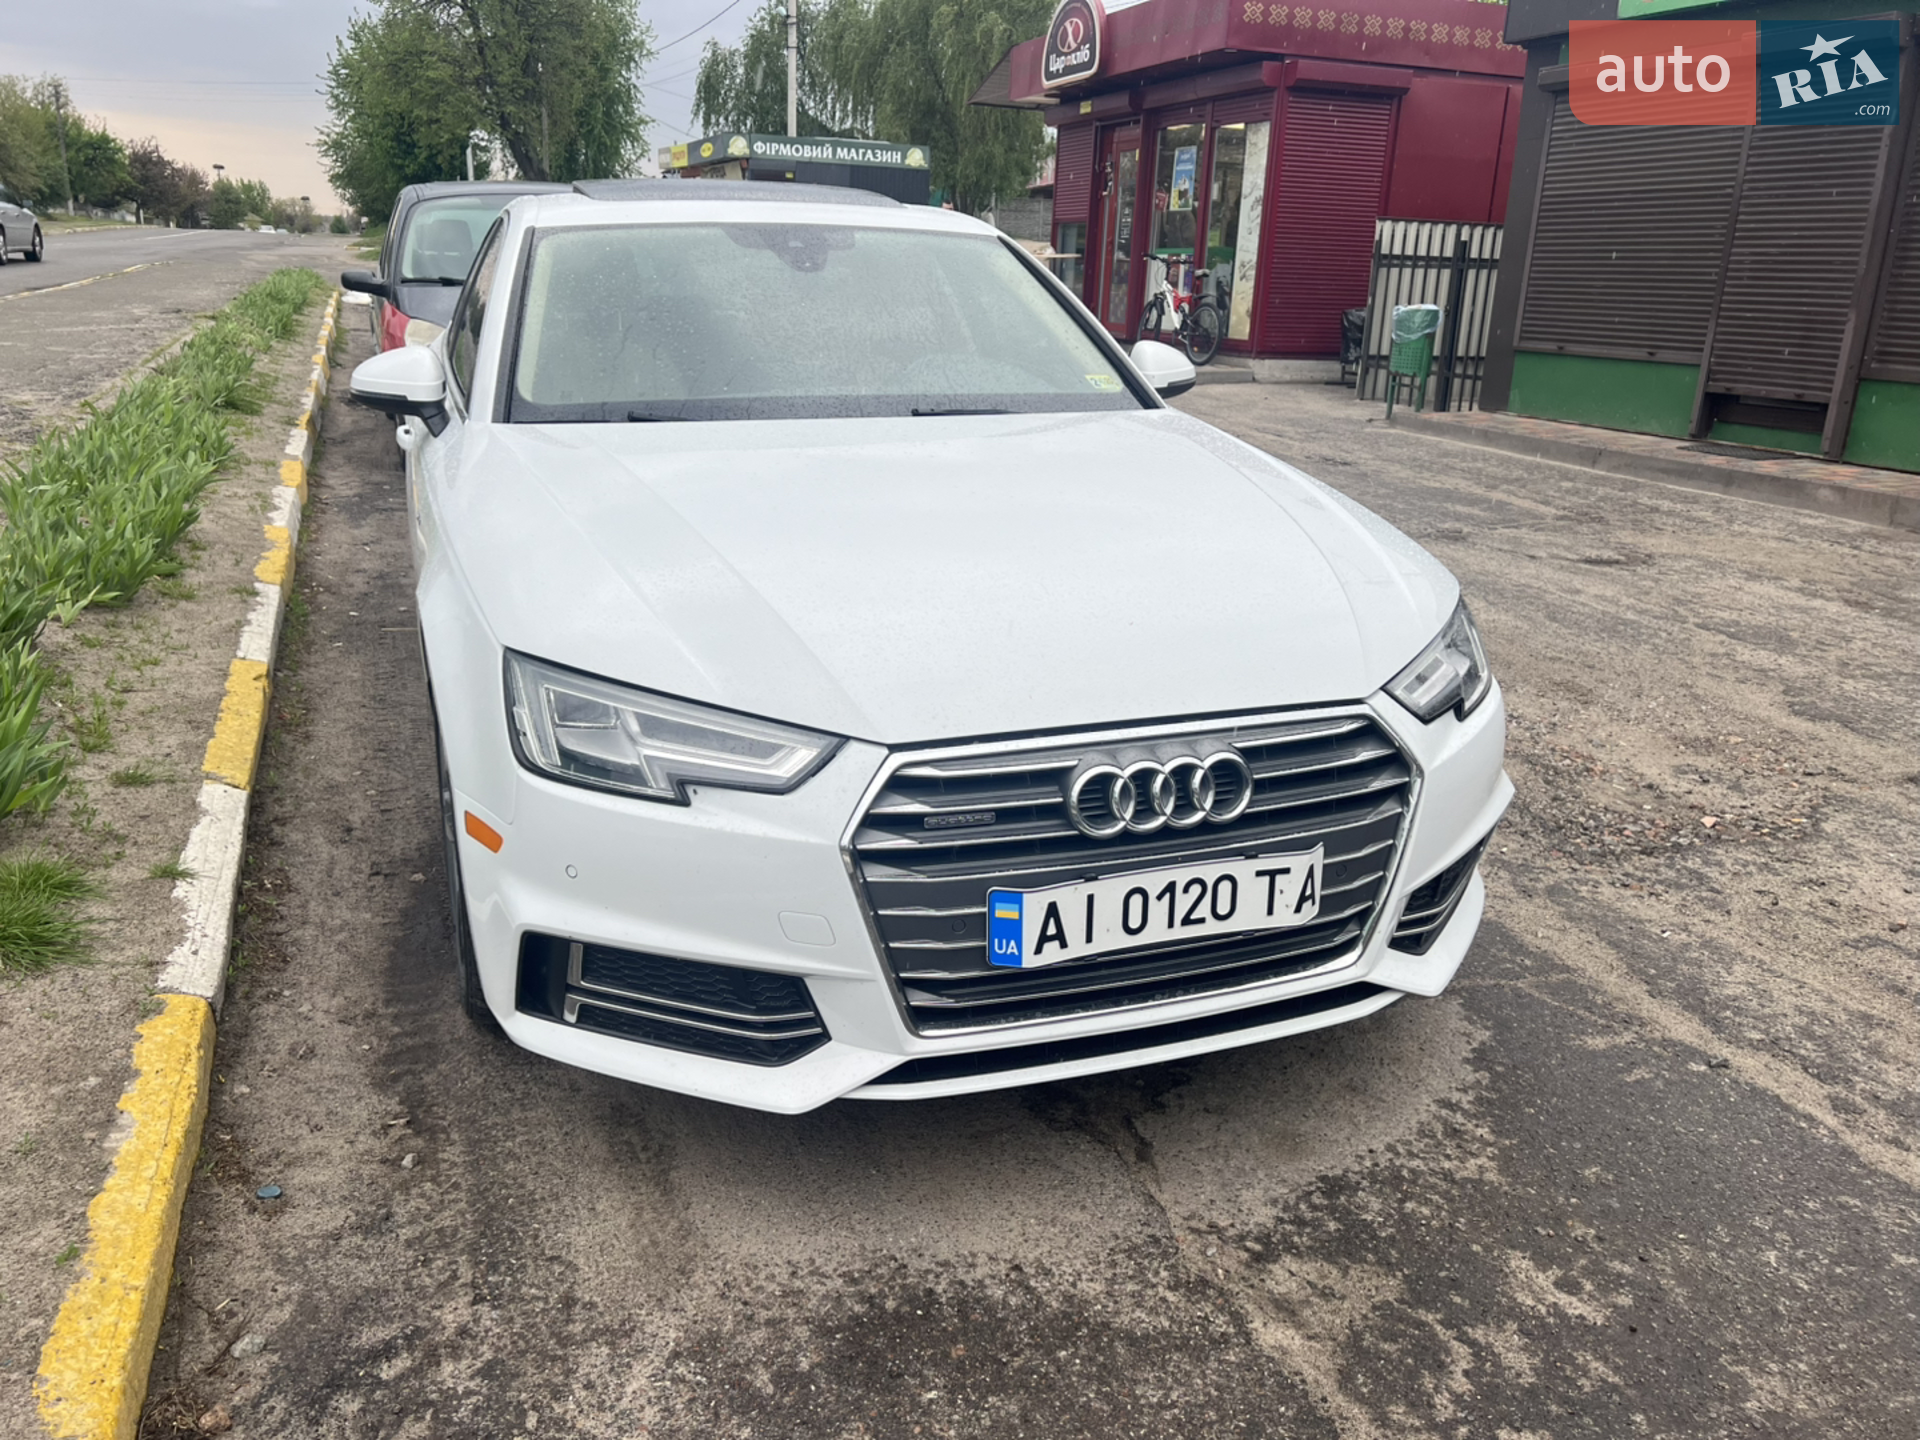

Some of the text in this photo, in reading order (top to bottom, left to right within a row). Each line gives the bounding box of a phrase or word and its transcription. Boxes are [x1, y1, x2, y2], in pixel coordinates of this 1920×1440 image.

[753, 141, 901, 164] ФІРМОВИЙ МАГАЗИН
[1033, 863, 1317, 956] AI 0120 TA
[993, 937, 1019, 957] UA
